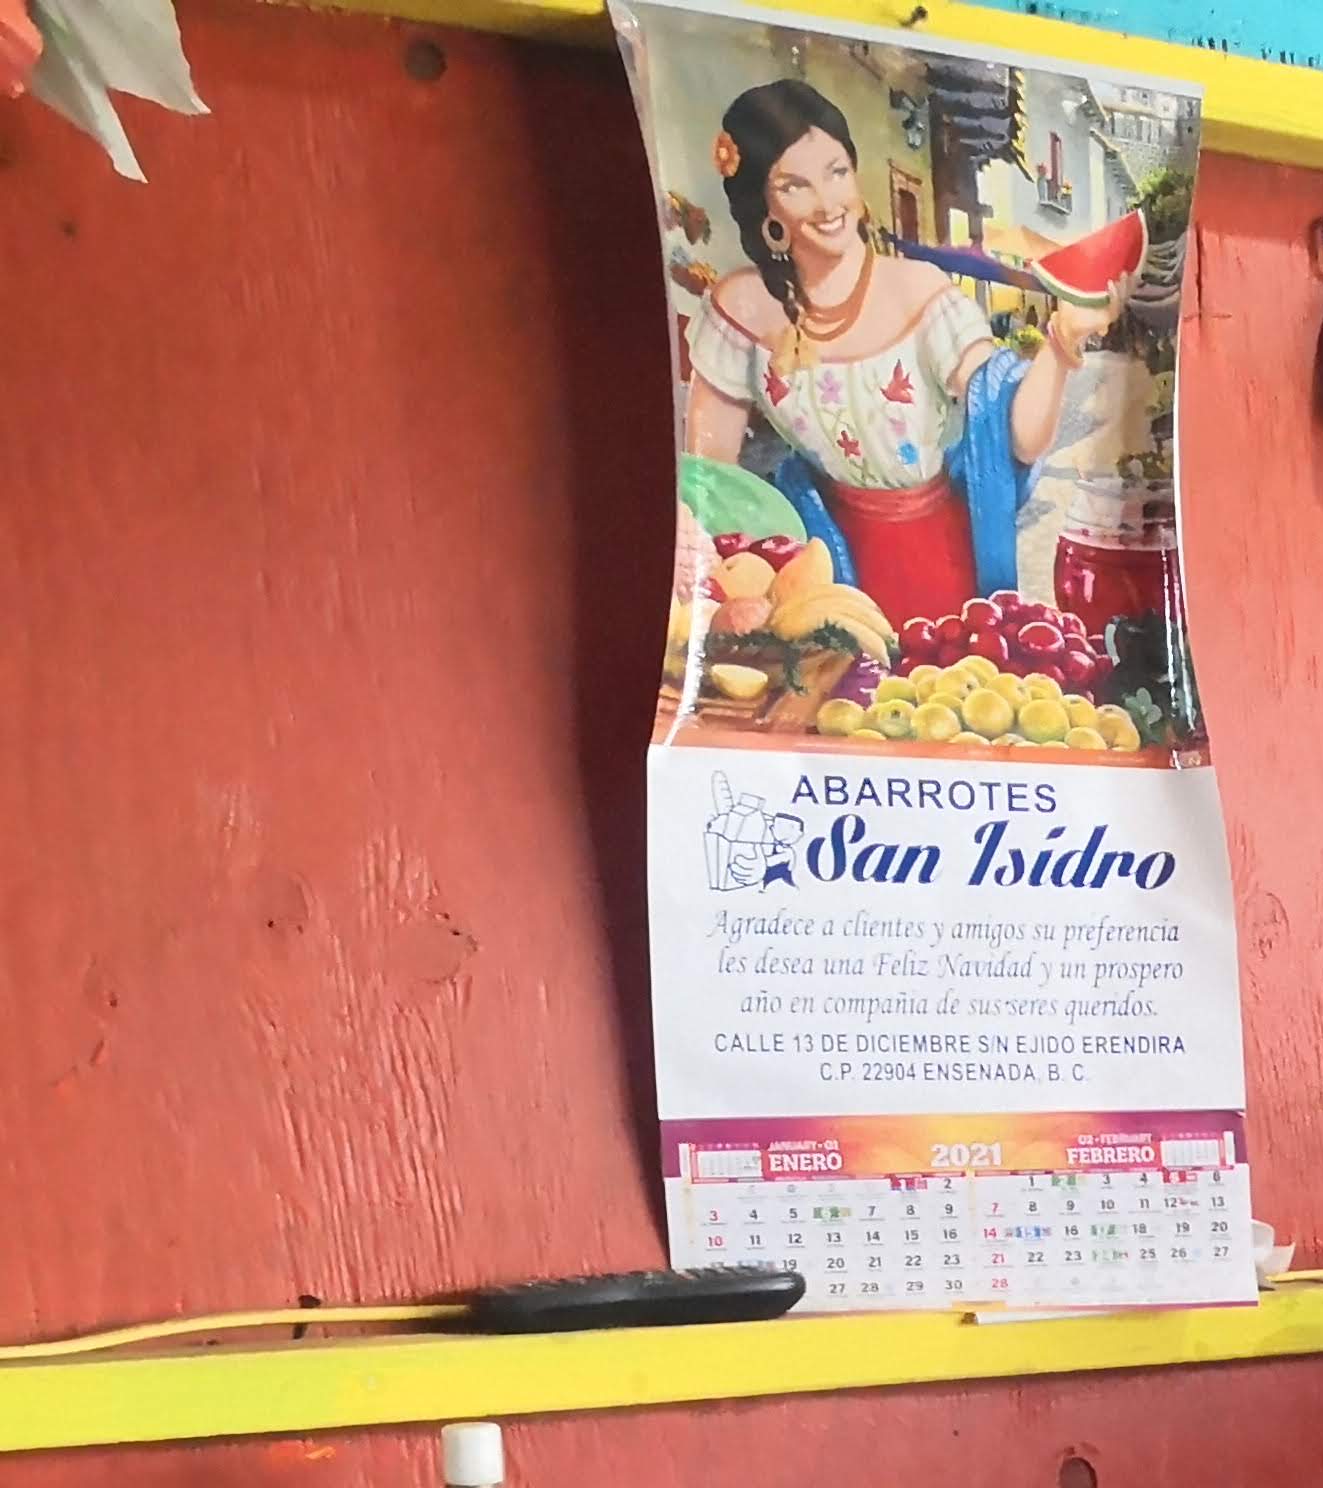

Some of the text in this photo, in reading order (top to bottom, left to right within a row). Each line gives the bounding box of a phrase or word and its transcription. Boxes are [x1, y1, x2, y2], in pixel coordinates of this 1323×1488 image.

[791, 774, 1057, 813] ABARROTES
[806, 814, 1176, 890] San Isidro
[706, 907, 1181, 951] Agradece a clientes y amigos su preferencia
[718, 945, 1184, 989] les desea una Feliz Navidad y un prospero
[740, 989, 783, 1014] año
[790, 996, 815, 1014] en
[936, 988, 961, 1015] de
[1064, 989, 1158, 1025] queridos.
[714, 1033, 1187, 1055] CALLE 13 DE DICIEMBRE S/N EJIDO ERENDIRA
[862, 1063, 917, 1081] 22904
[768, 1152, 844, 1172] ENERO
[930, 1143, 1003, 1167] 2021
[1066, 1146, 1156, 1165] FEBRERO
[943, 1178, 953, 1190] 2
[1103, 1174, 1112, 1186] 3
[1139, 1173, 1149, 1186] 4
[709, 1211, 718, 1222] 3
[749, 1210, 759, 1221] 4
[789, 1208, 799, 1220] 5
[867, 1206, 877, 1217] 7
[906, 1204, 917, 1217] 8
[944, 1204, 955, 1216] 9
[991, 1203, 1000, 1214] 7
[1027, 1201, 1038, 1213] 8
[1066, 1200, 1076, 1212] 9
[1100, 1199, 1116, 1210] 10
[1139, 1198, 1151, 1210] 11
[1163, 1197, 1179, 1209] 12
[1211, 1197, 1226, 1208] 13
[706, 1229, 959, 1248] 10 11 12 13 14 15 16
[983, 1228, 998, 1240] 14
[1064, 1226, 1080, 1237] 16
[1175, 1223, 1191, 1235] 19
[1210, 1222, 1229, 1233] 20
[782, 1258, 798, 1271] 19
[827, 1257, 846, 1270] 20
[867, 1256, 883, 1269] 21
[905, 1255, 922, 1267] 22
[943, 1254, 962, 1266] 23
[992, 1253, 1005, 1265] 21
[1027, 1252, 1045, 1263] 22
[1064, 1251, 1083, 1263] 23
[1139, 1249, 1157, 1261] 25
[1170, 1249, 1188, 1259] 26
[1213, 1247, 1230, 1258] 27
[829, 1280, 964, 1295] 27 28 29 30
[991, 1278, 1009, 1289] 28
